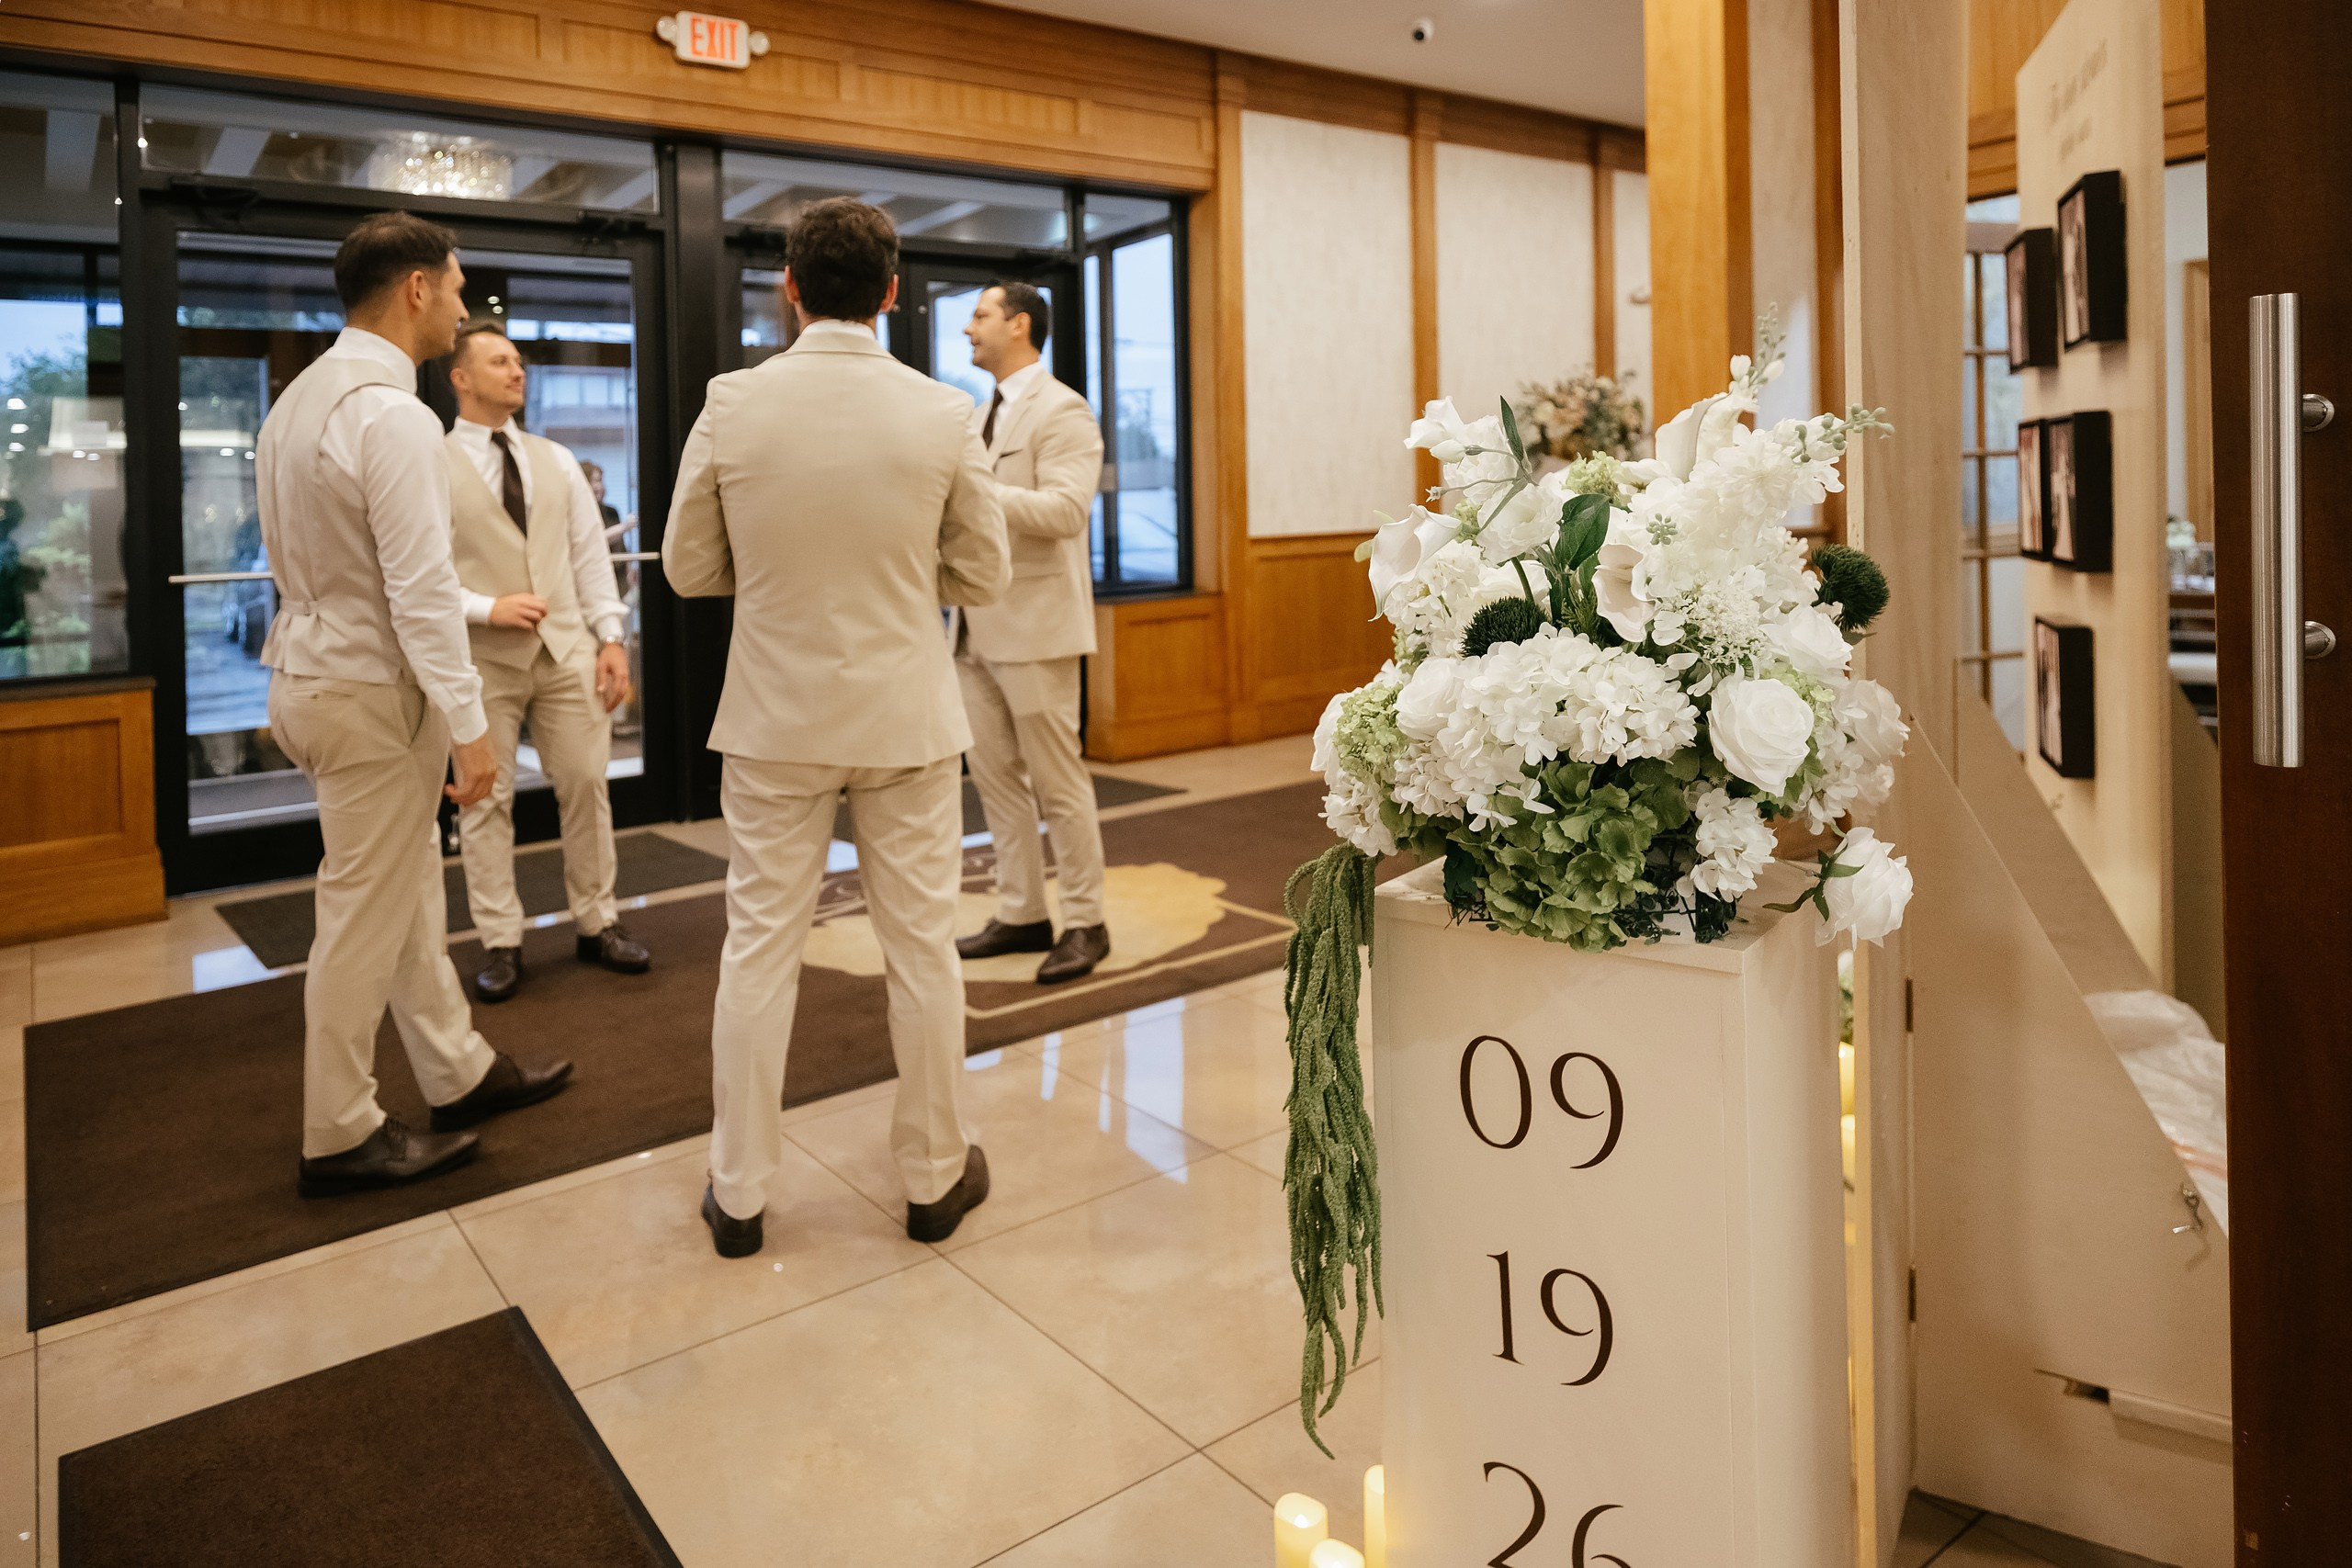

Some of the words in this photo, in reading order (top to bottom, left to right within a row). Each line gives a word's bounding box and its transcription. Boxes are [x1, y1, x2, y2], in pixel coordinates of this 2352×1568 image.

[691, 17, 739, 61] EXIT
[1459, 1034, 1623, 1169] 09
[1486, 1250, 1613, 1387] 19
